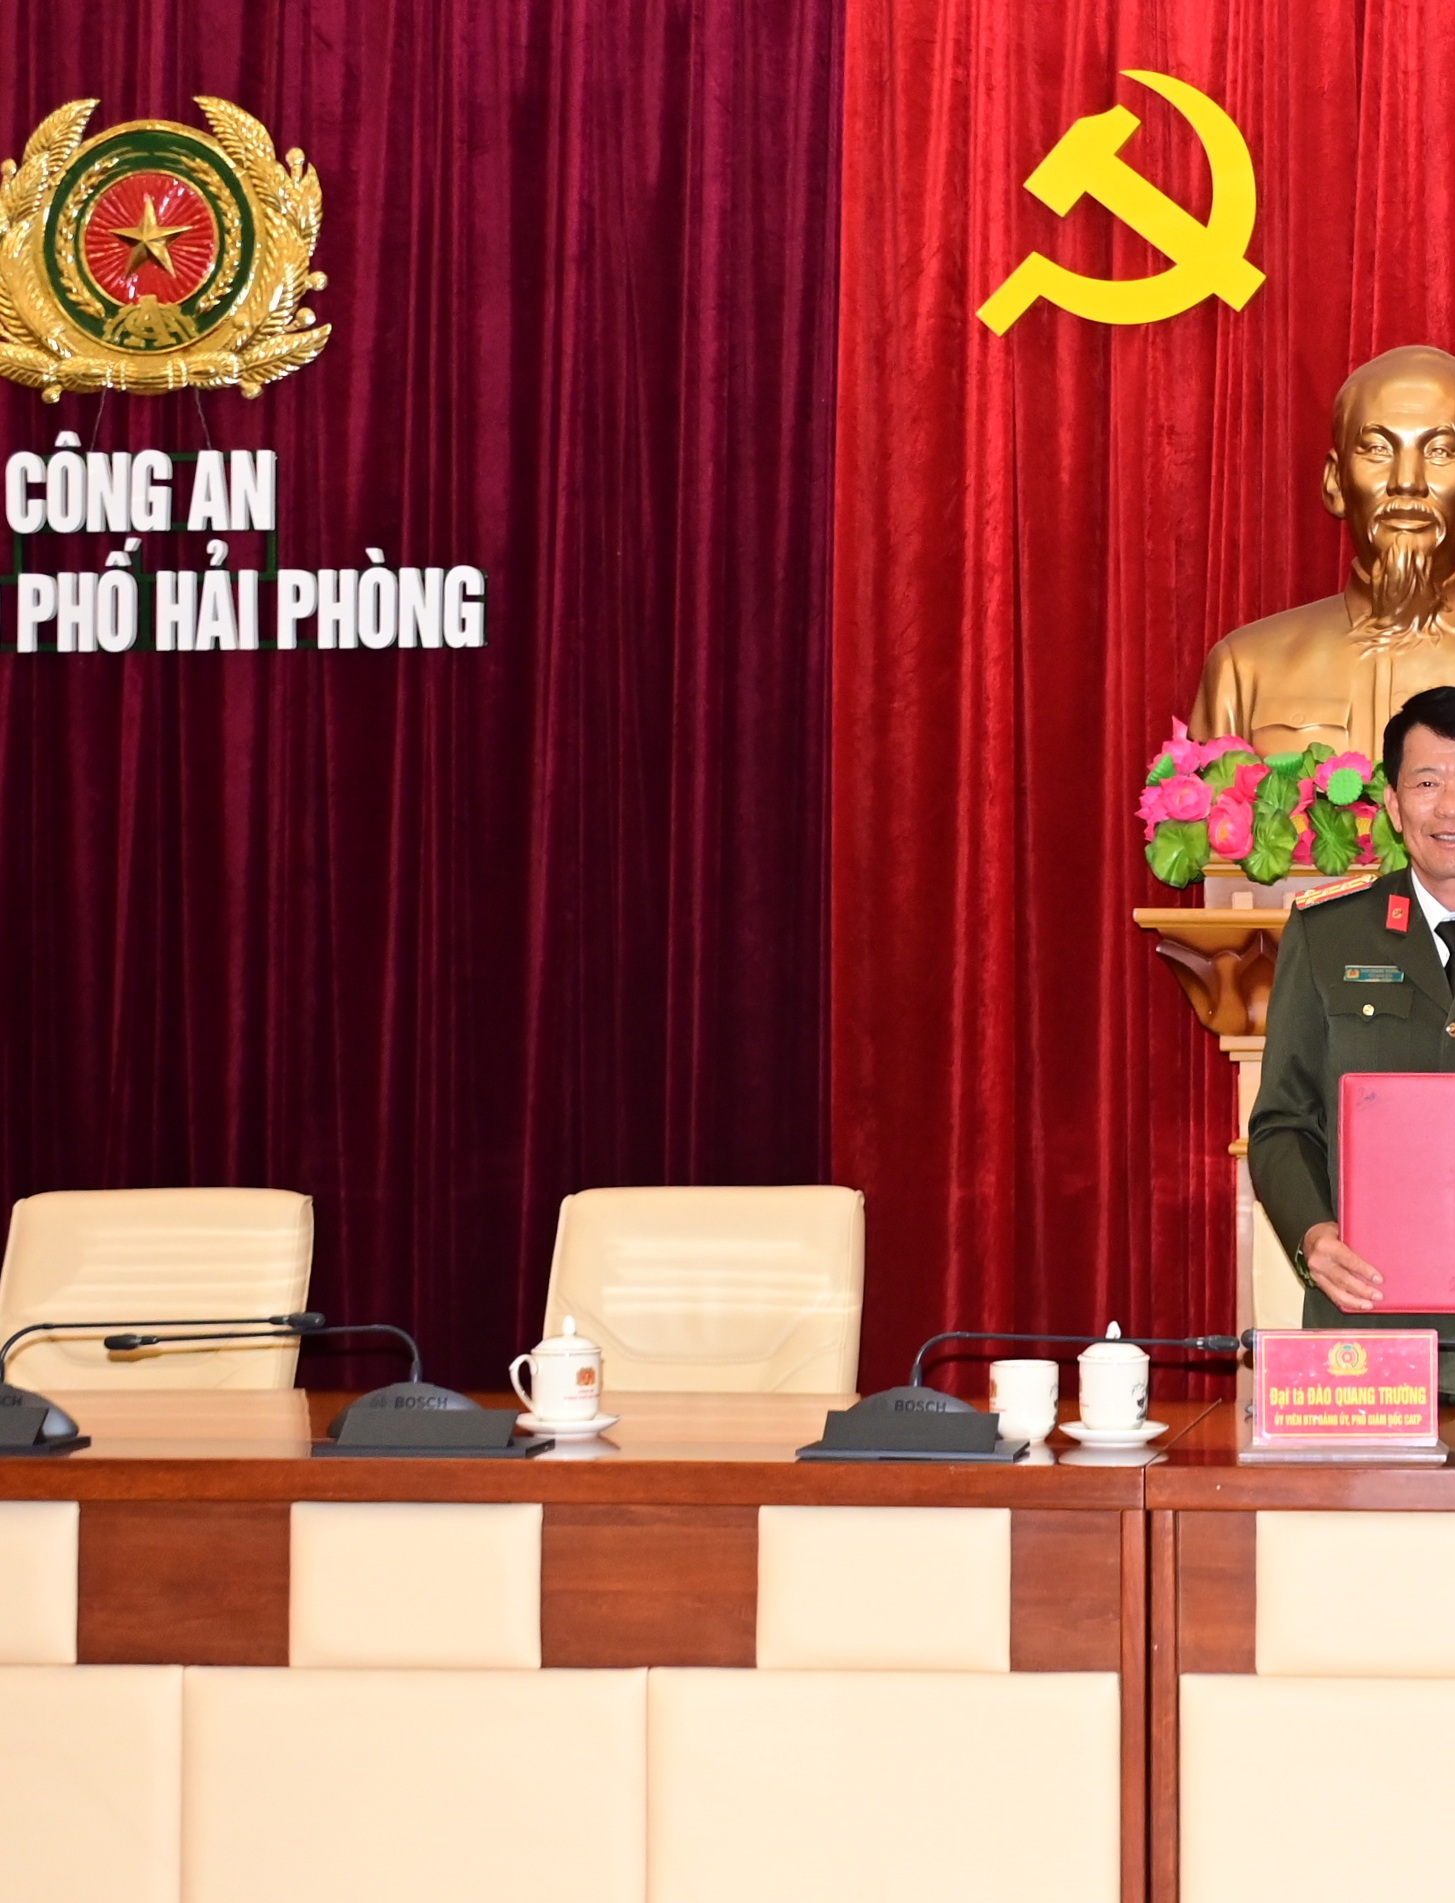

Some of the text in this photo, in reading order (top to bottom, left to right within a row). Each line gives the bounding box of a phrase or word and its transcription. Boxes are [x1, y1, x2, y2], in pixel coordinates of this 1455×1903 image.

[5, 431, 277, 533] CÔNG AN
[17, 538, 486, 653] PHỐ HẢI PHÒNG
[394, 1395, 448, 1409] BOSCH
[894, 1399, 947, 1413] BOSCH
[1293, 1386, 1304, 1406] tá
[1307, 1384, 1331, 1406] ĐÀO
[1335, 1386, 1375, 1407] QUANG
[1378, 1383, 1427, 1406] TRƯỜNG
